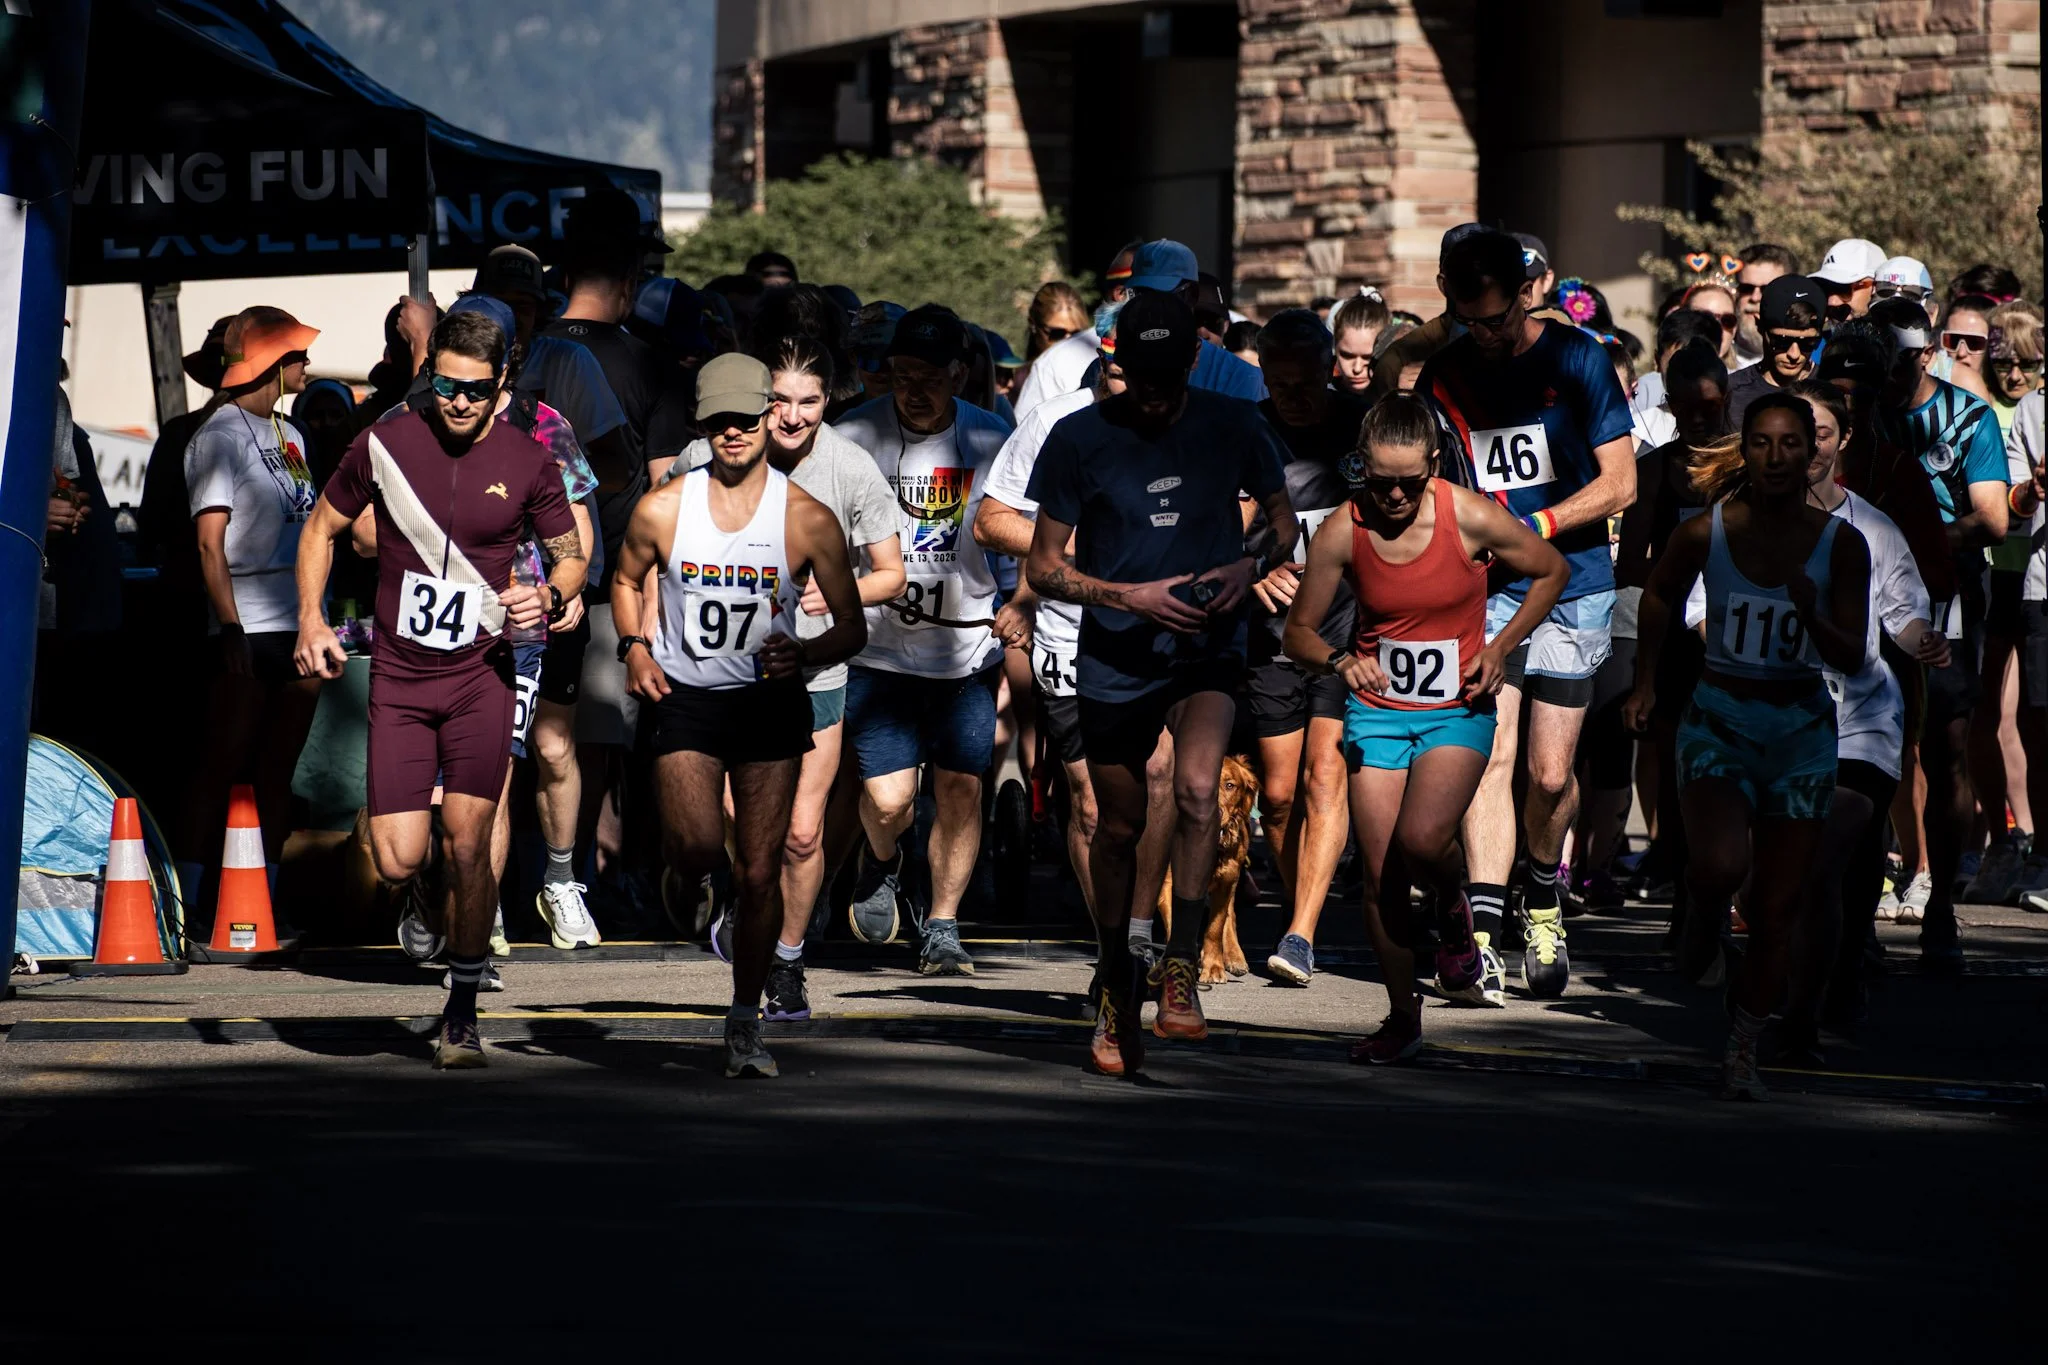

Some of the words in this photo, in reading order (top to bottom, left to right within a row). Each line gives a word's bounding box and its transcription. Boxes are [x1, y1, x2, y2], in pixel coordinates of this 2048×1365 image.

[252, 147, 388, 201] FUN
[917, 475, 948, 486] SAM'S
[1486, 433, 1540, 483] 46
[891, 486, 962, 503] AINBOW
[1149, 479, 1180, 490] KEEN
[681, 561, 778, 588] PRIDE
[934, 553, 957, 562] 2026
[409, 583, 466, 643] 34
[700, 600, 759, 651] 97
[900, 580, 944, 626] 81
[1732, 601, 1802, 662] 119
[1390, 647, 1444, 697] 92
